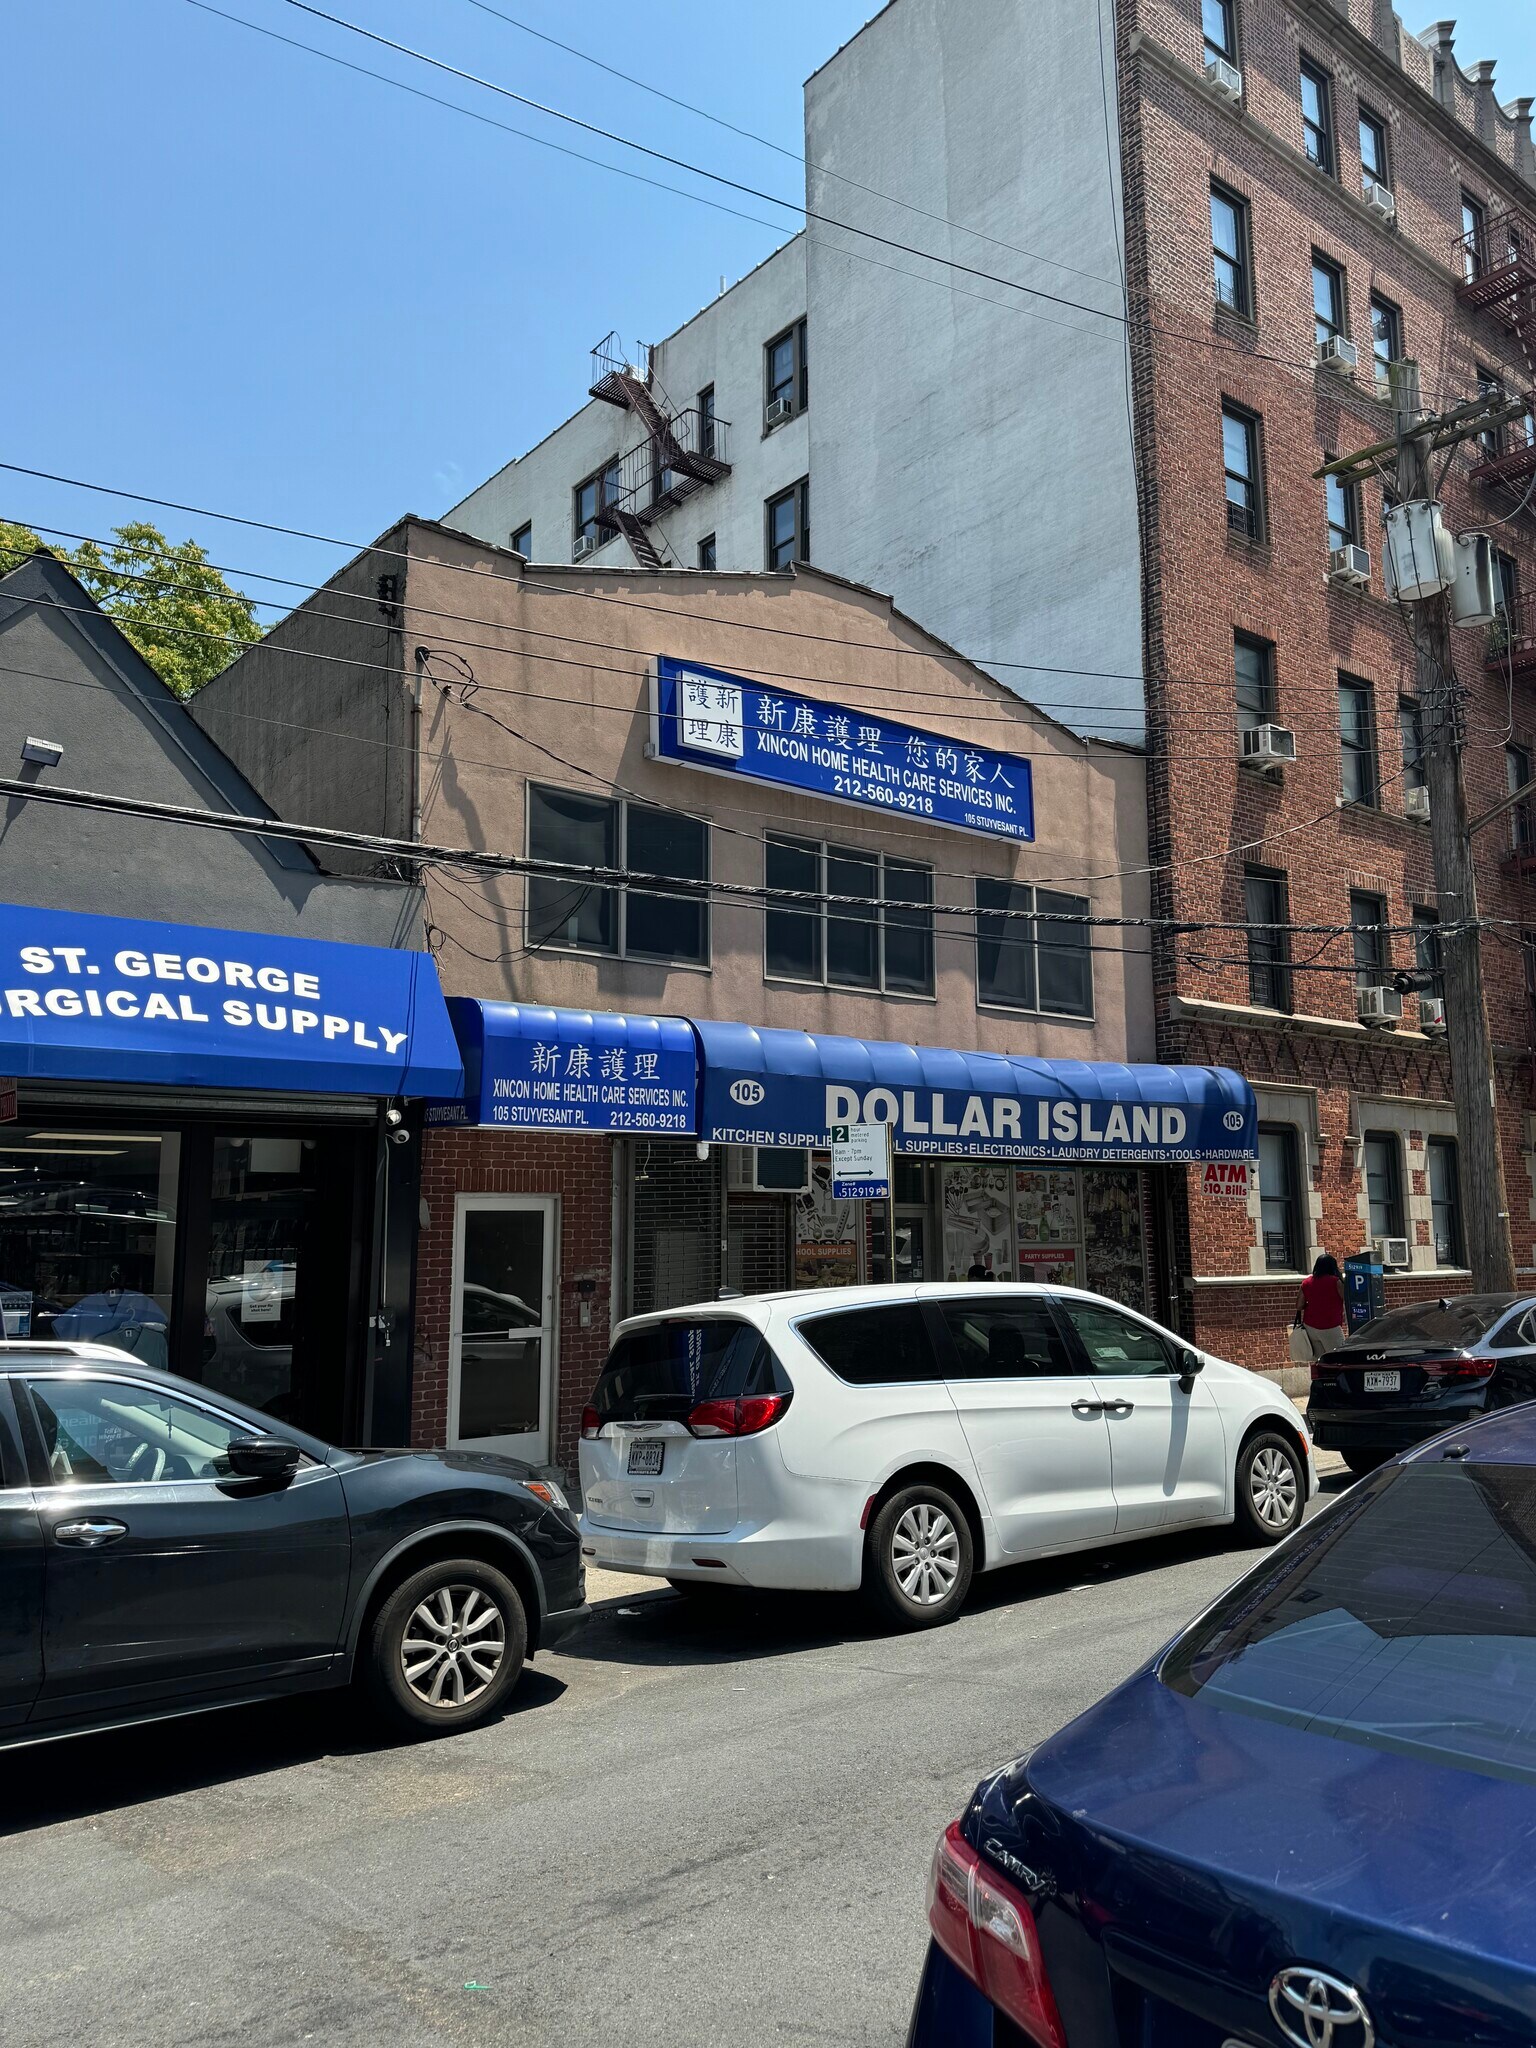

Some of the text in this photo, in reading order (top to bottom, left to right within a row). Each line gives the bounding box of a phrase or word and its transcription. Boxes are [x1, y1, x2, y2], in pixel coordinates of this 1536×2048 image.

[756, 694, 1015, 789] 新康護理 您的家人
[757, 731, 1017, 814] XINCON HOME HEALTH CARE SERVICES INC.
[833, 775, 933, 814] 212-560-9218
[964, 812, 976, 825] 105
[976, 815, 1018, 835] STUYVESANT
[20, 946, 321, 1000] ST. GEORGE
[0, 988, 409, 1054] RGICAL SUPPLY
[529, 1042, 661, 1082] 新康護理
[492, 1078, 688, 1107] XINCON HOME HEALTH CARE SERVICES INC.
[734, 1083, 760, 1101] 105
[492, 1106, 589, 1125] 105 STUYVESANT PL.
[610, 1111, 686, 1129] 212-560-9218
[825, 1084, 1187, 1143] DOLLAR ISLAND
[1225, 1114, 1242, 1128] 105
[712, 1128, 774, 1144] KITCHEN
[836, 1127, 845, 1141] 2
[905, 1140, 963, 1154] SUPPLIES
[969, 1143, 1046, 1157] ELECTRONICS
[1051, 1147, 1100, 1159] LAUNDRY
[1102, 1148, 1166, 1160] DETERGENTS
[1170, 1149, 1201, 1160] TOOLS
[1205, 1149, 1255, 1159] HARDWARE
[1204, 1163, 1247, 1183] ATM
[841, 1187, 875, 1197] 512919
[1203, 1183, 1247, 1196] $10. Bills
[817, 1247, 852, 1256] SUPPLIES
[1354, 1274, 1365, 1290] P
[984, 1837, 1046, 1891] CAMRY
